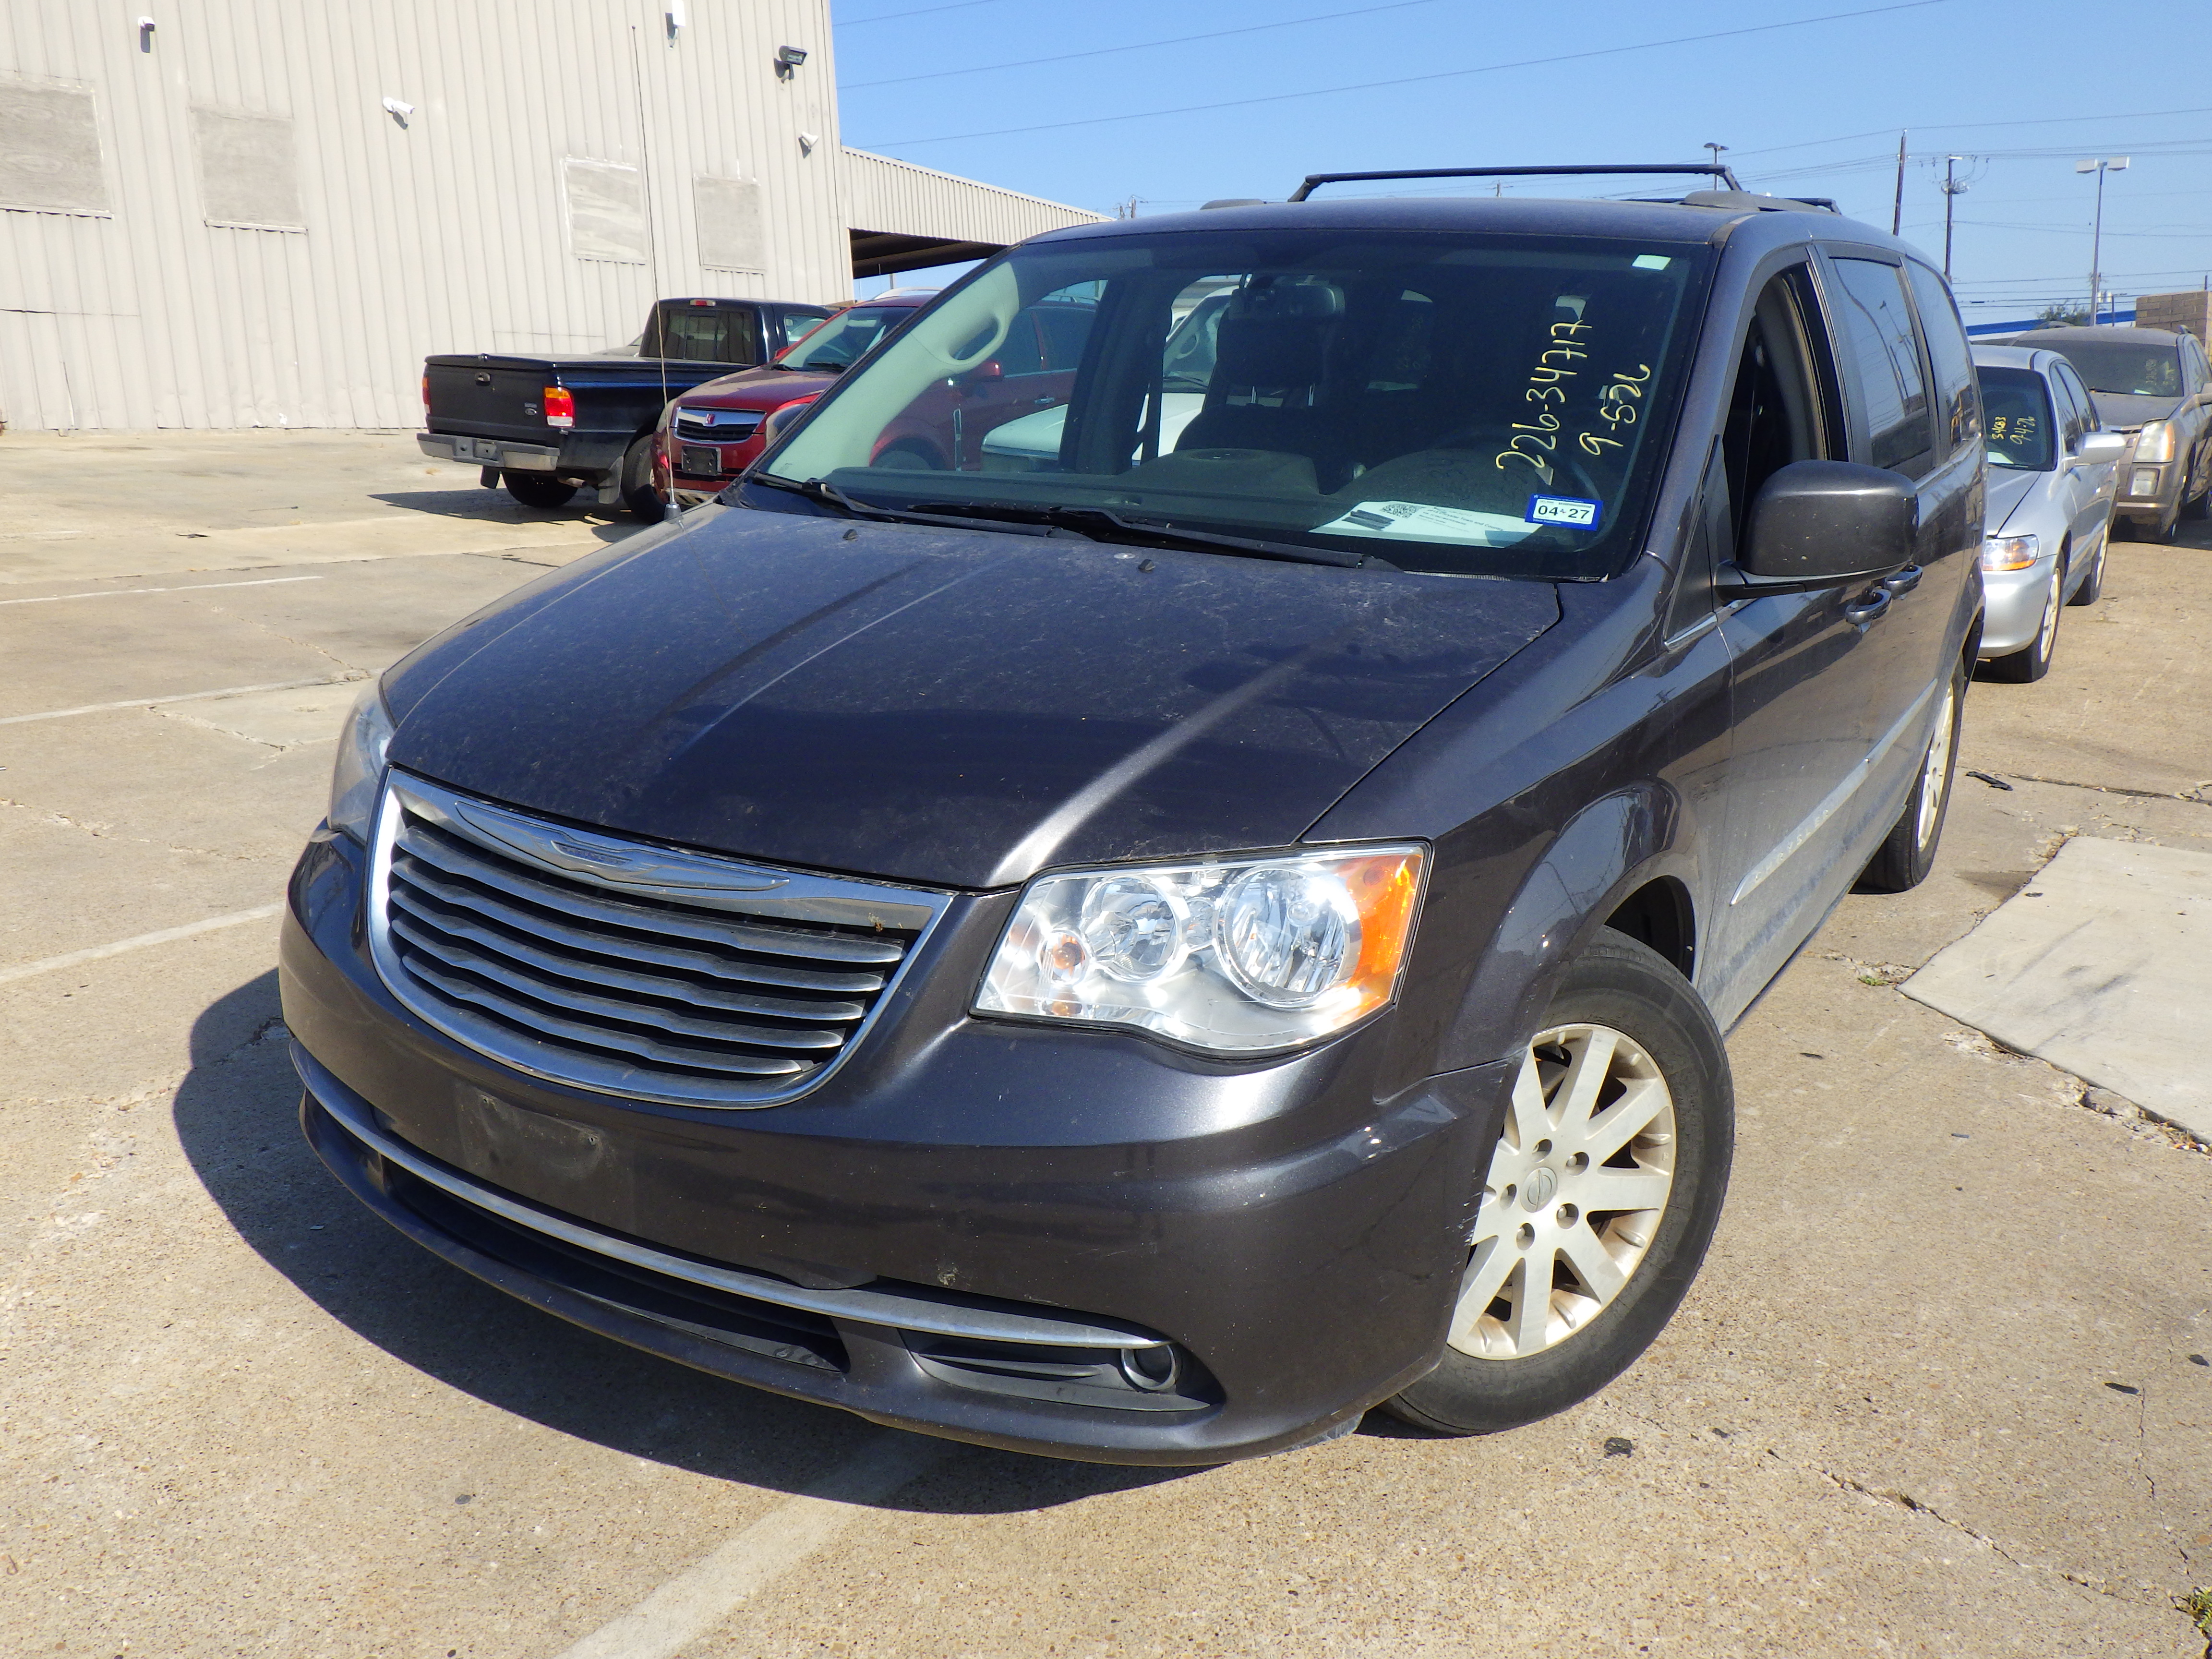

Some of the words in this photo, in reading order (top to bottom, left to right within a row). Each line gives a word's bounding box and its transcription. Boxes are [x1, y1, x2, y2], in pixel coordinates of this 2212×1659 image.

[1495, 319, 1593, 469] 226-34717
[1538, 505, 1559, 516] 04
[1567, 508, 1590, 519] 27
